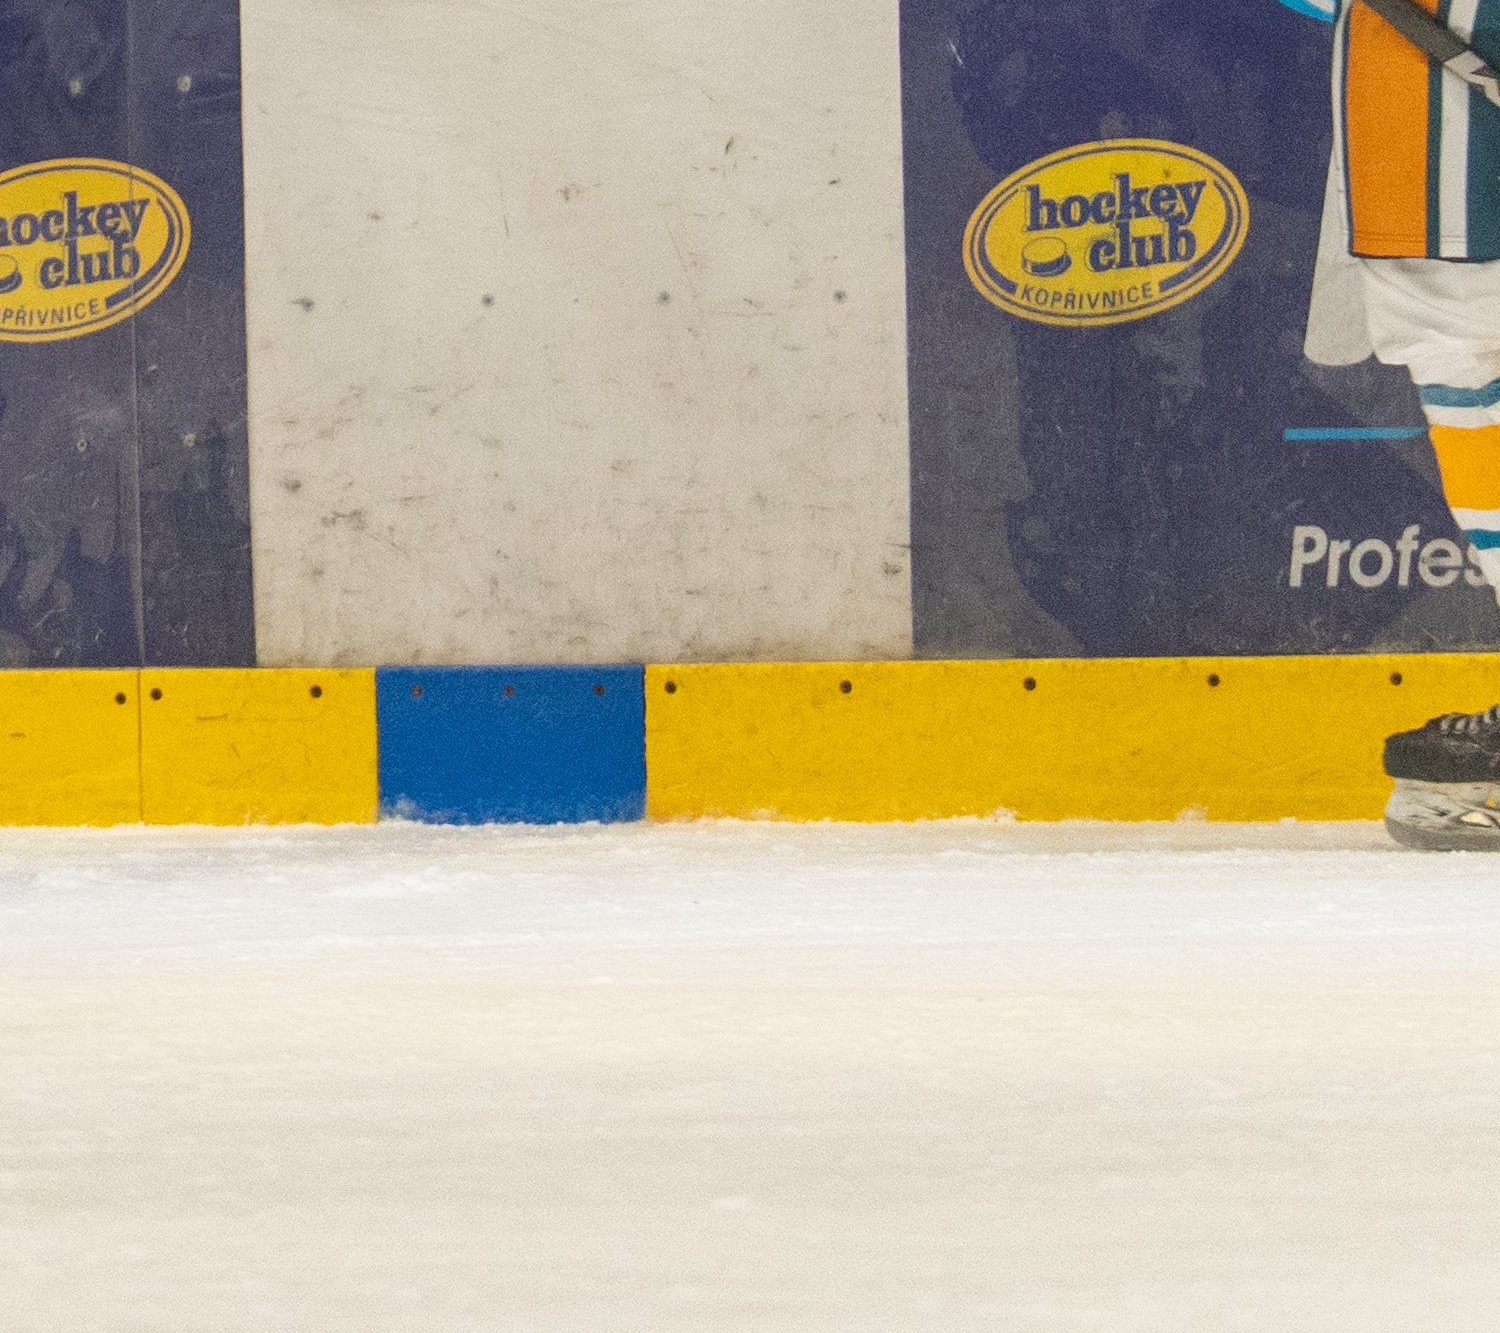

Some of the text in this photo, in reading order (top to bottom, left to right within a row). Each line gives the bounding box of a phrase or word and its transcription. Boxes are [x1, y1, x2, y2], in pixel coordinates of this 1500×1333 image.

[1026, 171, 1209, 233] hockey
[37, 236, 141, 291] club
[1086, 218, 1198, 273] club
[1018, 277, 1156, 311] KOPŘIVNICE
